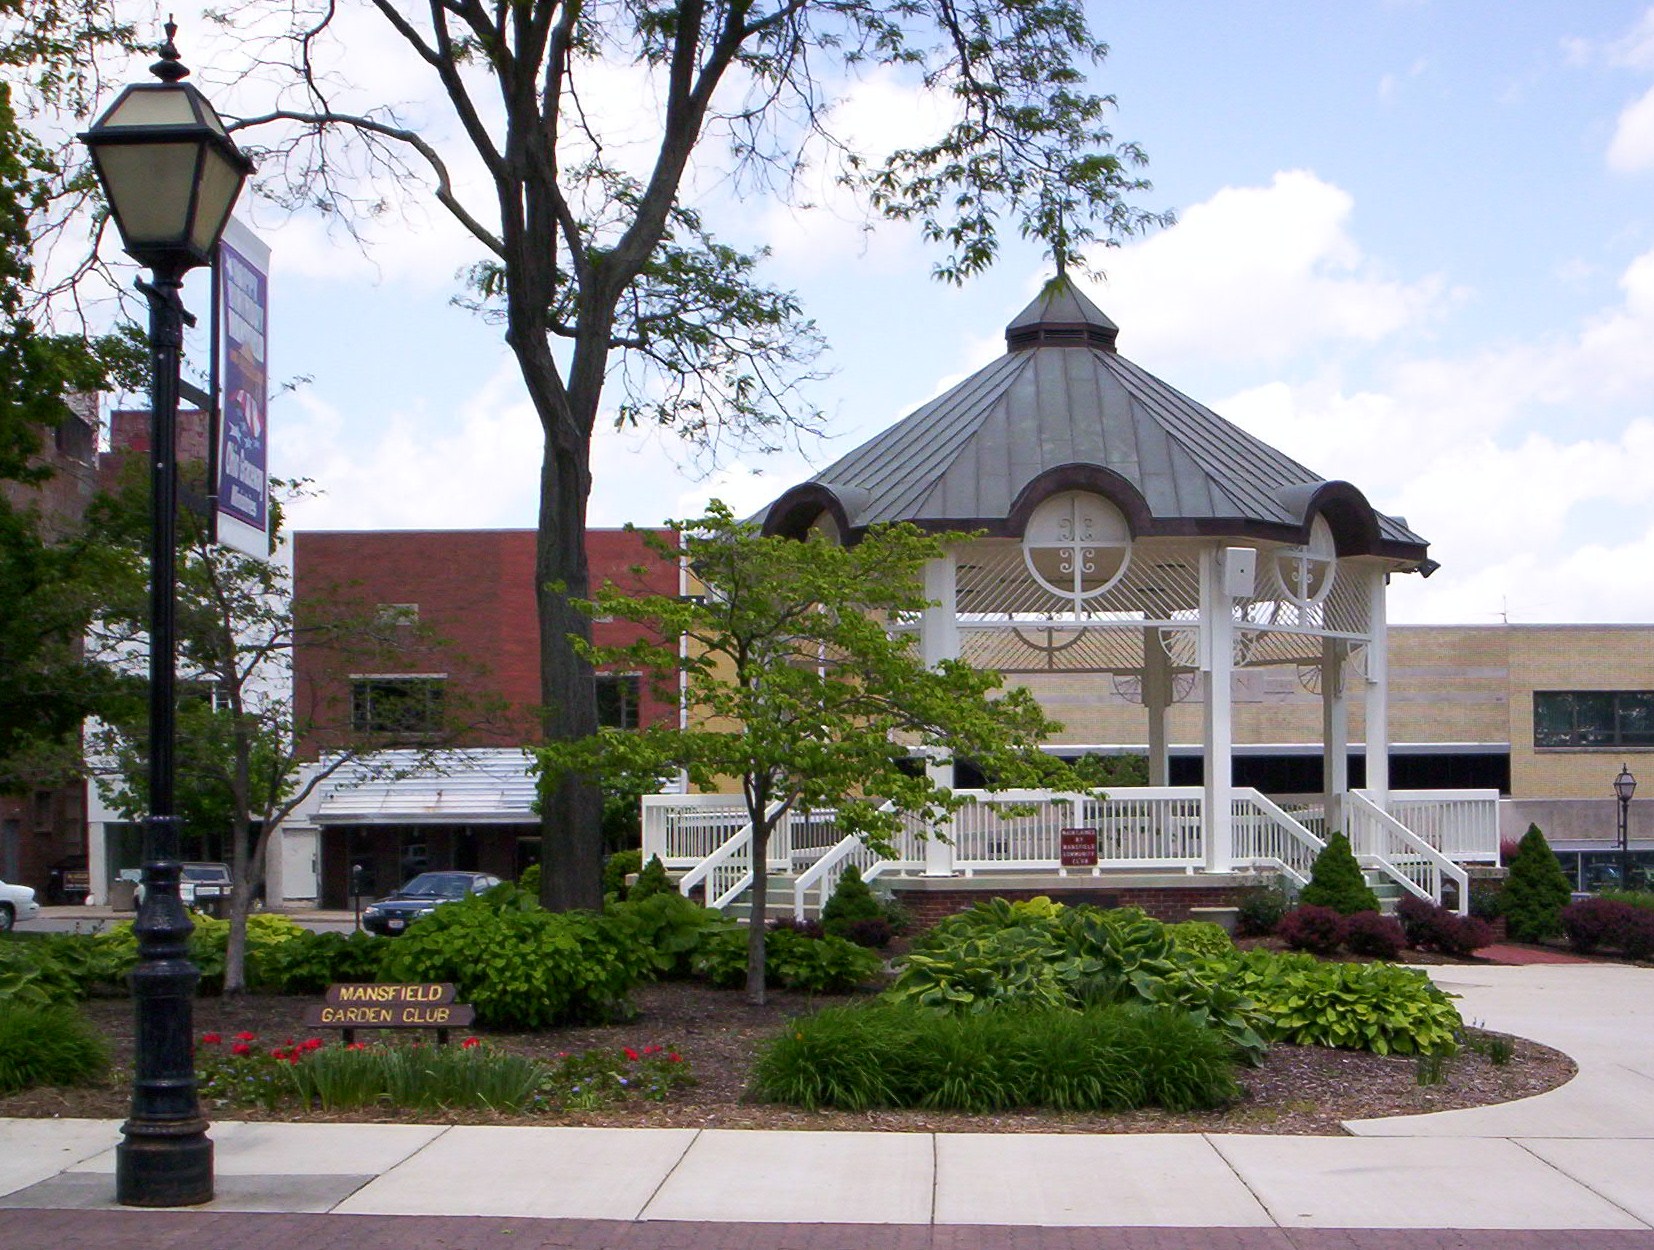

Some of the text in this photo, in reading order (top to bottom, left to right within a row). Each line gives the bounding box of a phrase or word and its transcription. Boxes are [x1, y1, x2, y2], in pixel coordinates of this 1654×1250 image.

[339, 985, 442, 1001] MANSFIELD
[321, 1007, 450, 1023] GARDEN CLUB
